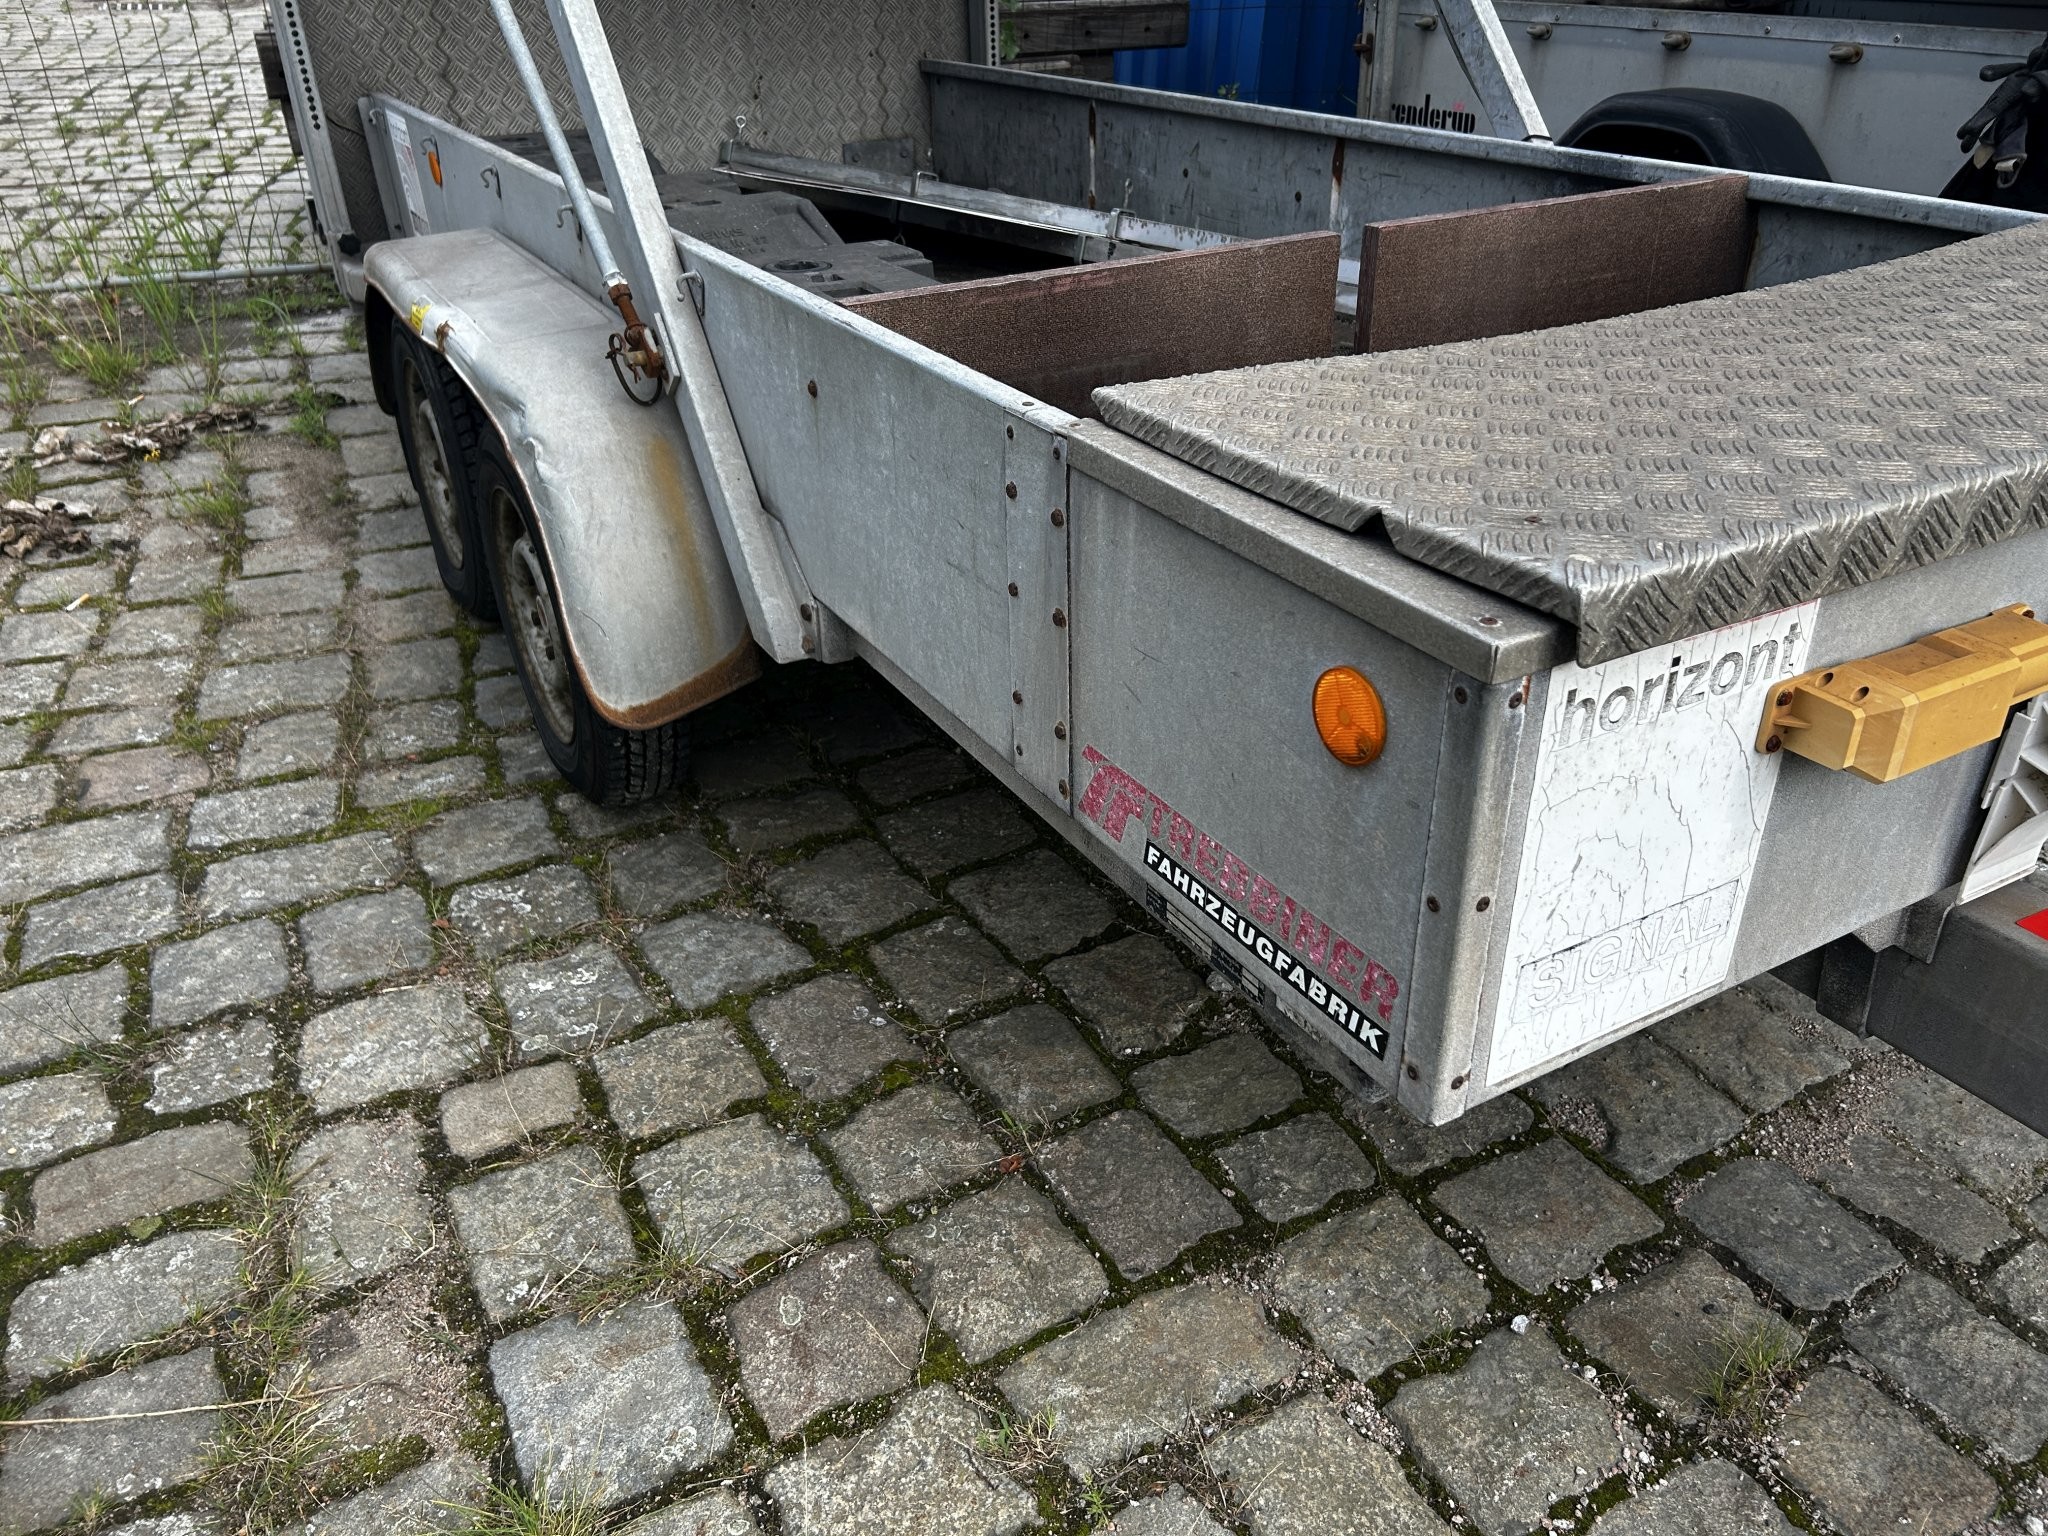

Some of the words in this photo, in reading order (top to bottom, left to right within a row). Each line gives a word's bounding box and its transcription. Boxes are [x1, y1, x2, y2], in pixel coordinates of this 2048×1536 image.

[1391, 94, 1476, 134] enderup
[1559, 622, 1802, 747] horizont
[1147, 844, 1385, 1054] FAHRZEUGFABRIK
[1148, 791, 1400, 1024] TREBBINER
[1527, 896, 1723, 1010] SIGNAL
